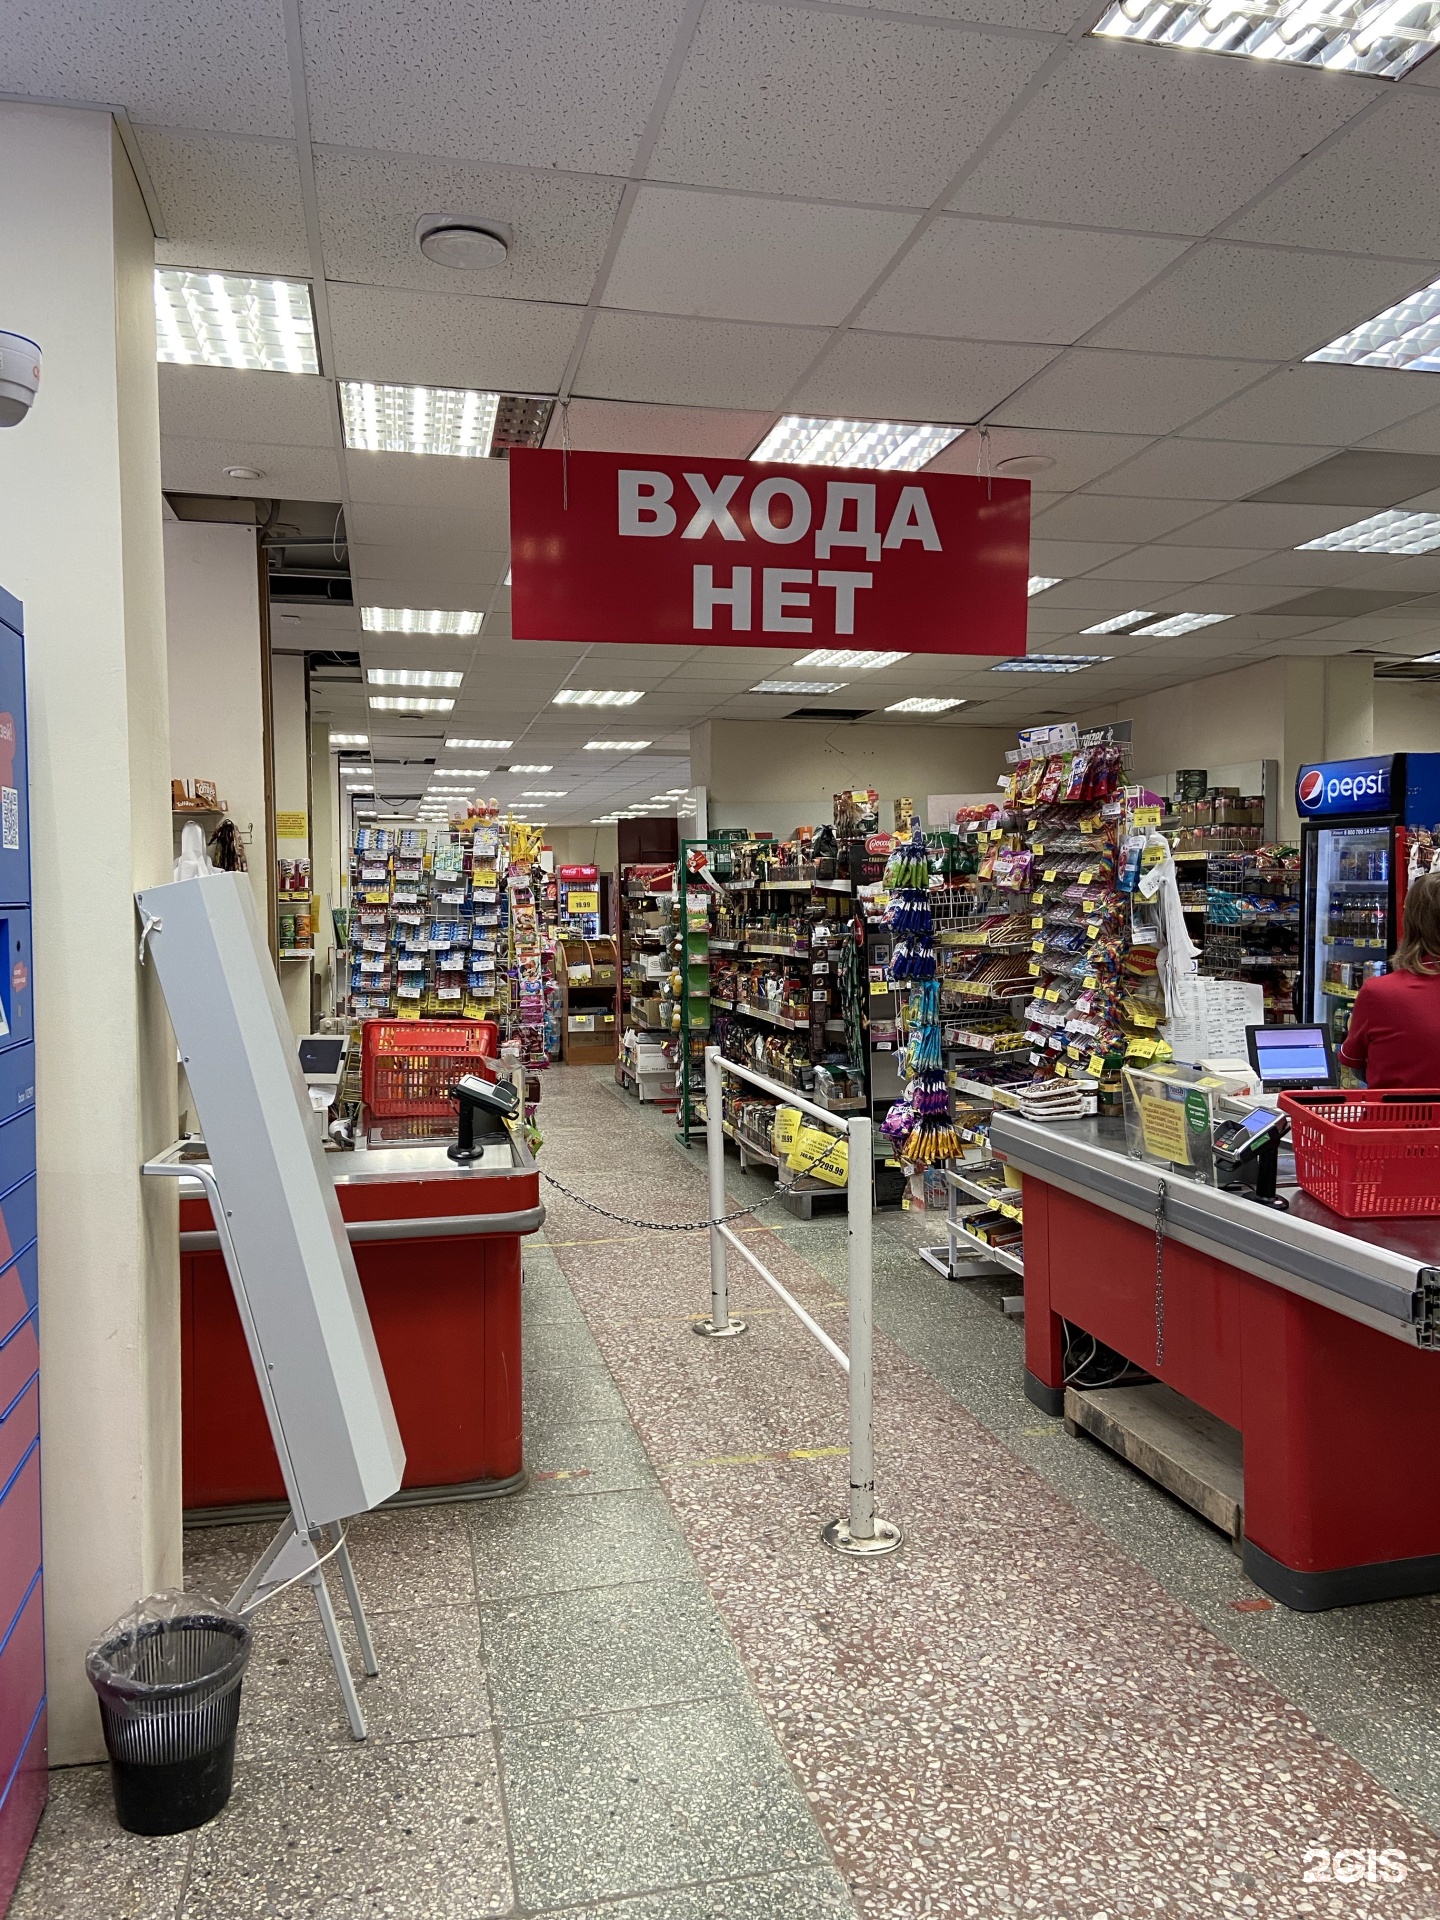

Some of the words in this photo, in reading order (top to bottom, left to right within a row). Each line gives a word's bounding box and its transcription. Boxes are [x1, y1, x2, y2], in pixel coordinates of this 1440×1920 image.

[617, 469, 943, 562] ВХОДА
[692, 564, 873, 635] НЕТ
[1327, 769, 1383, 803] pepsi
[861, 863, 880, 875] 350
[1128, 953, 1157, 966] Magg
[819, 1161, 845, 1177] 299.99
